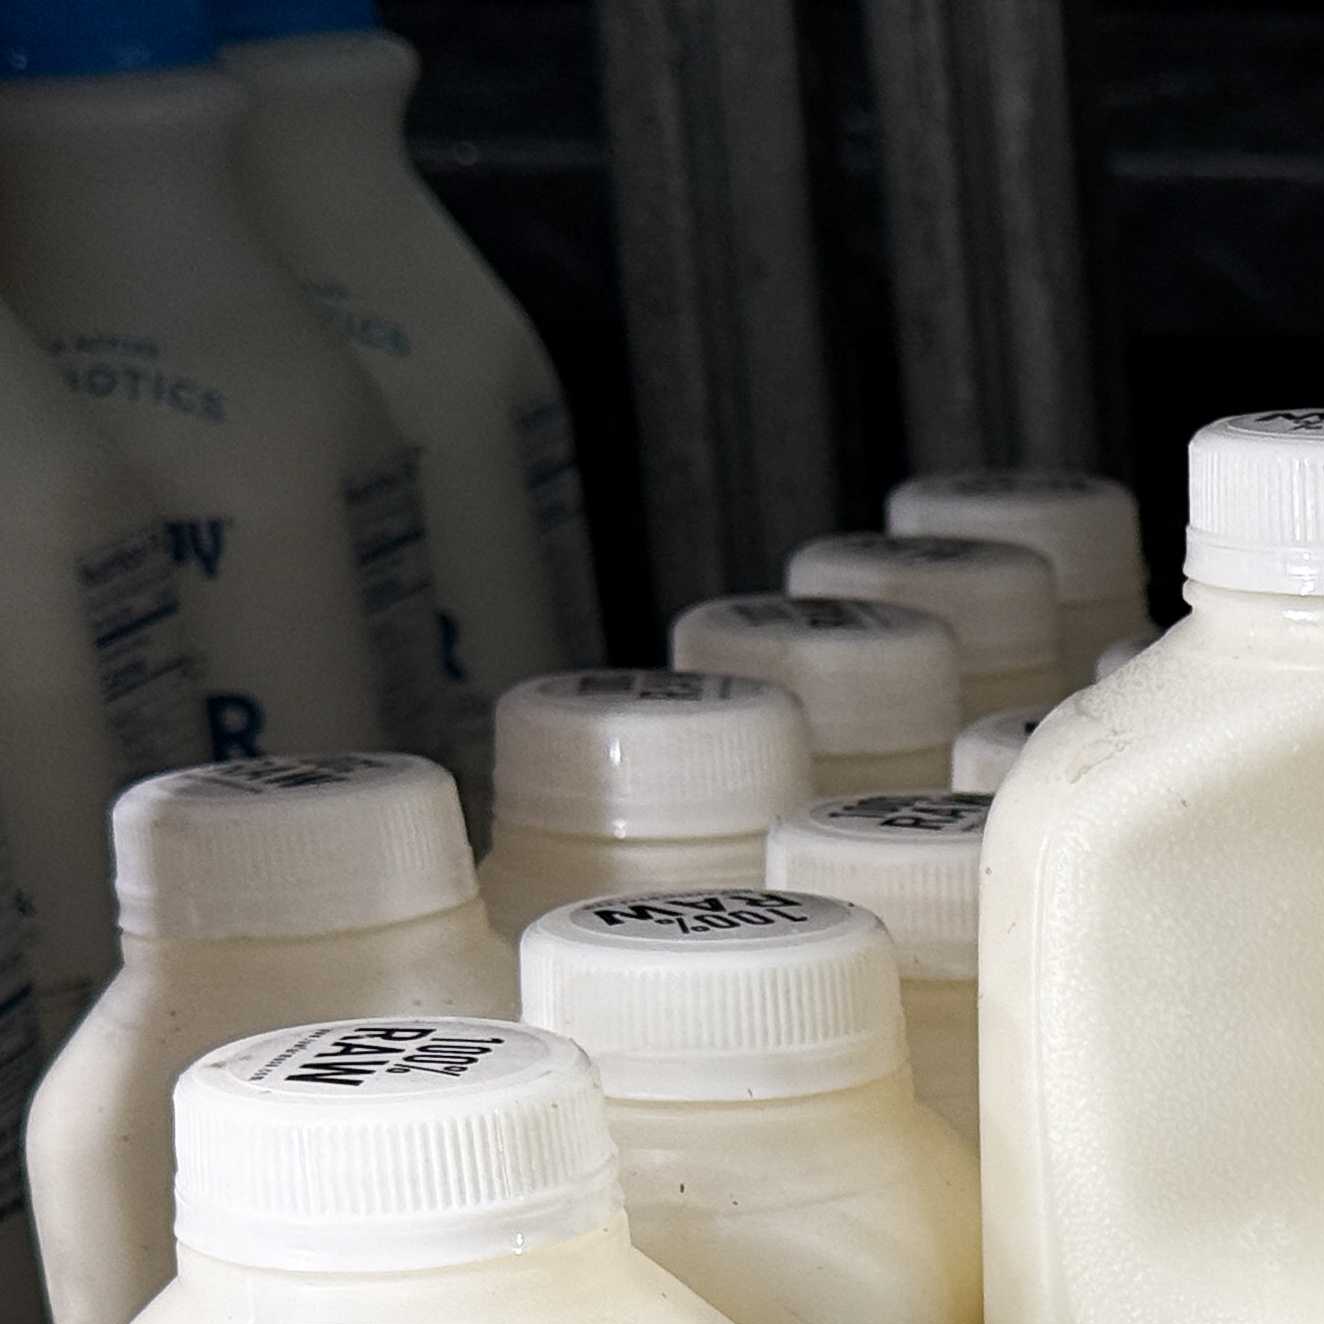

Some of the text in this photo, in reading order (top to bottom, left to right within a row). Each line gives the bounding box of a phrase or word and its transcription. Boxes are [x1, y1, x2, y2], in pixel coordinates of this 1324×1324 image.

[655, 906, 808, 934] 100%
[284, 1027, 437, 1086] RAW
[386, 1037, 505, 1077] 100%
